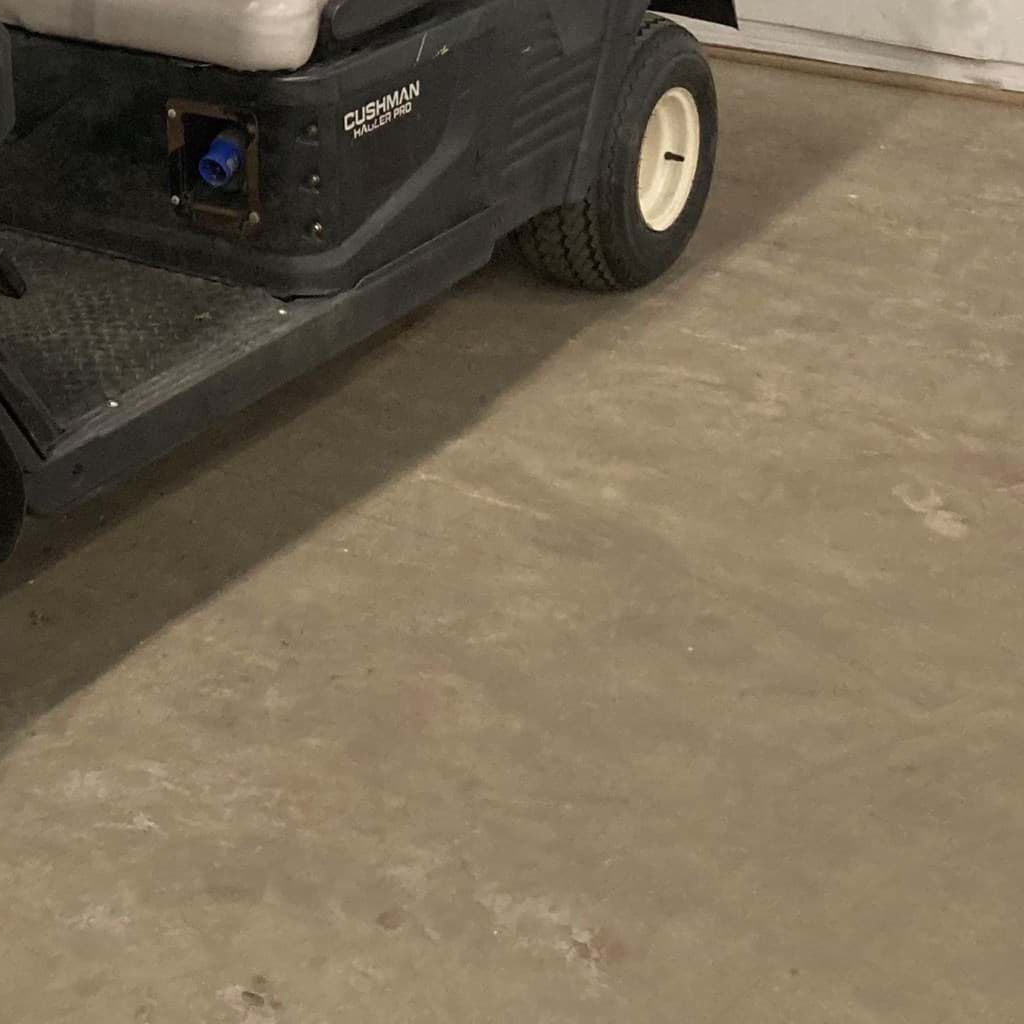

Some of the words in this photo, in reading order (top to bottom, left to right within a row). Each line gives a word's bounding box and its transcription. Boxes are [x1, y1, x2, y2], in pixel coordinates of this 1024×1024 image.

[344, 80, 420, 131] CUSHMAN
[353, 112, 392, 139] HAULER
[393, 101, 412, 119] PRO
